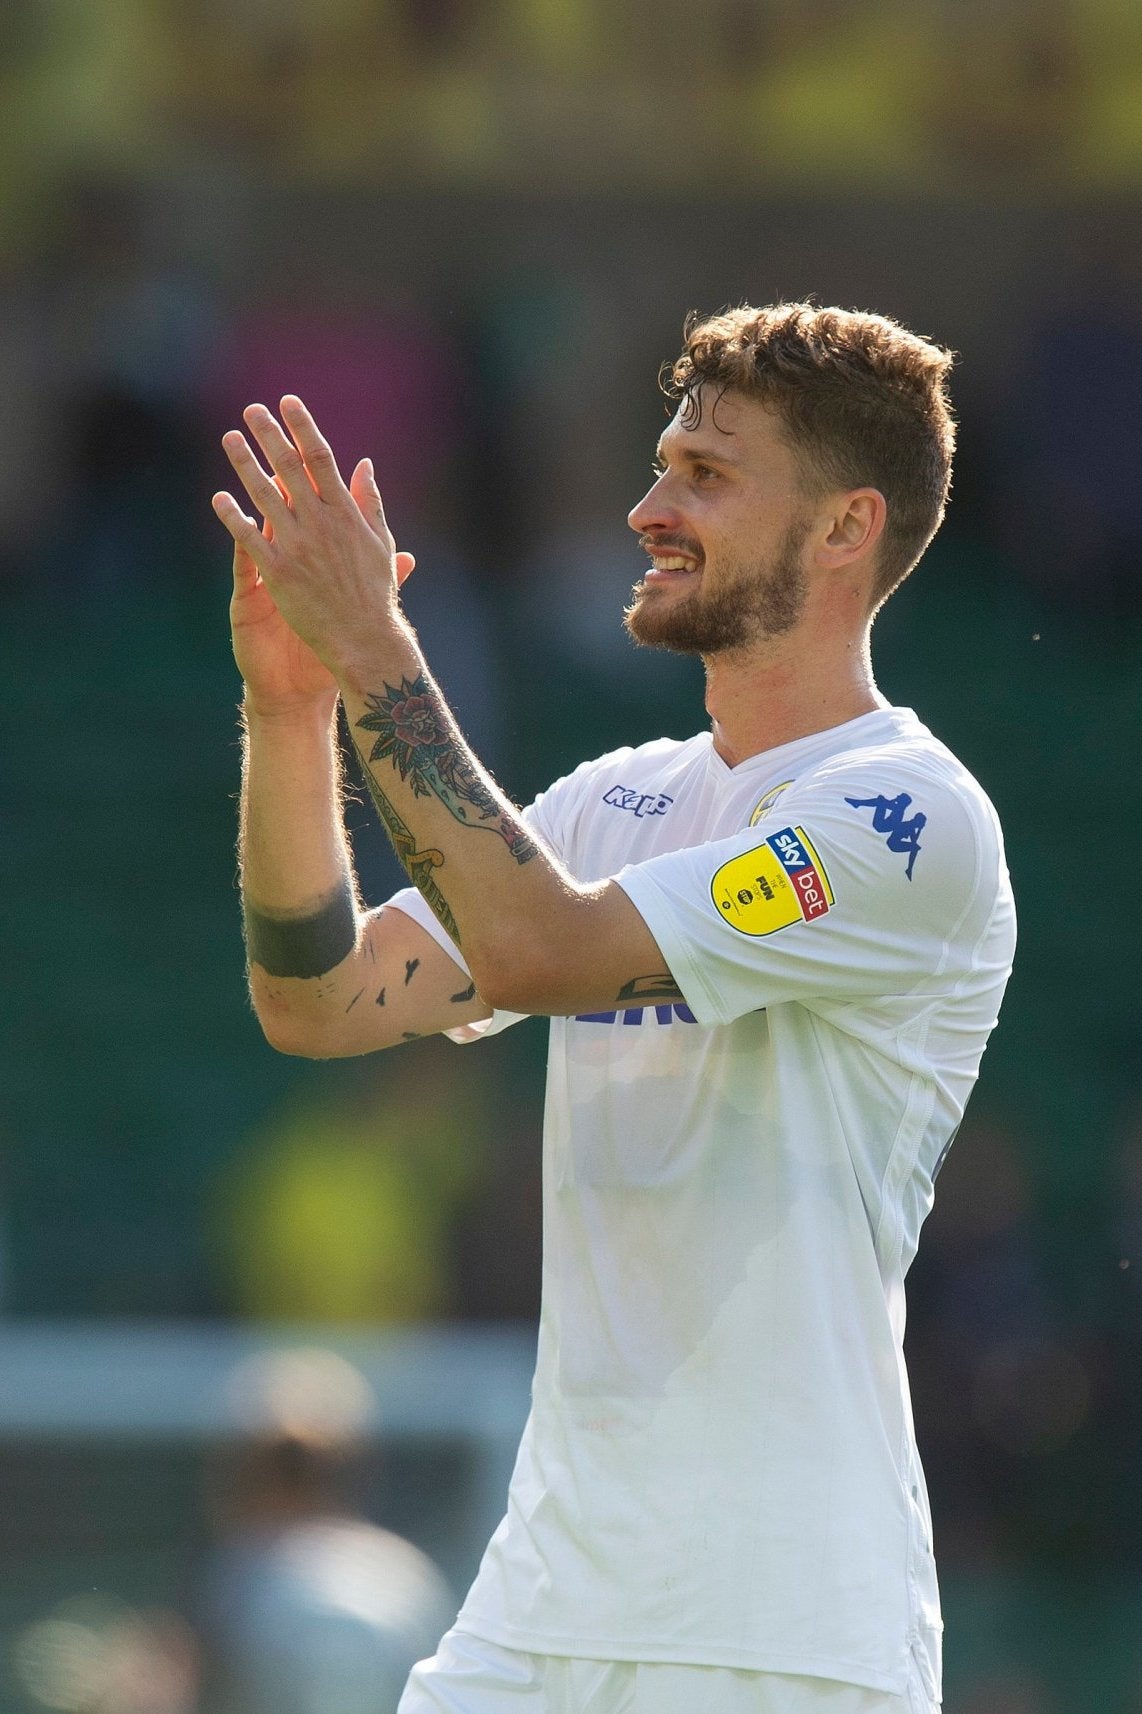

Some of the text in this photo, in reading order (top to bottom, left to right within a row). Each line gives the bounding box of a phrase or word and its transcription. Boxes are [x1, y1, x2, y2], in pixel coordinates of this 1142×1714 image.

[755, 875, 775, 901] FUN
[775, 834, 824, 915] sky bet
